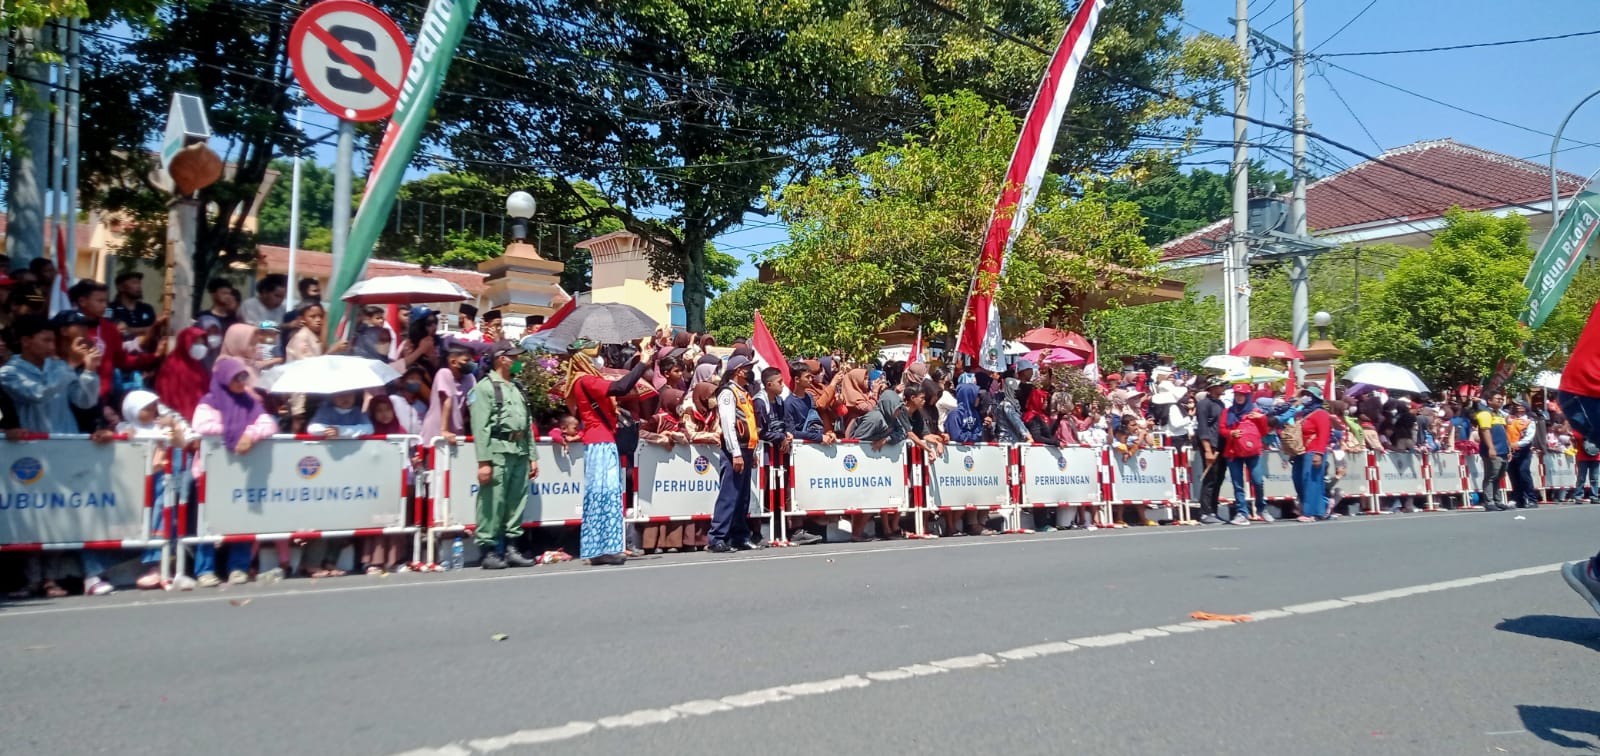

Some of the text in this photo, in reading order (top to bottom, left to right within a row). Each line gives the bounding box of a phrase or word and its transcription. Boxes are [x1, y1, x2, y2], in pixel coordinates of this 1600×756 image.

[325, 24, 377, 94] S
[655, 480, 722, 493] PERHUBUN
[809, 475, 893, 489] PERHUBUNGAN
[939, 475, 999, 488] PERHUBUNGAN
[1034, 474, 1090, 486] PERHUBUNGAN
[232, 485, 380, 504] PERHUBUNGAN
